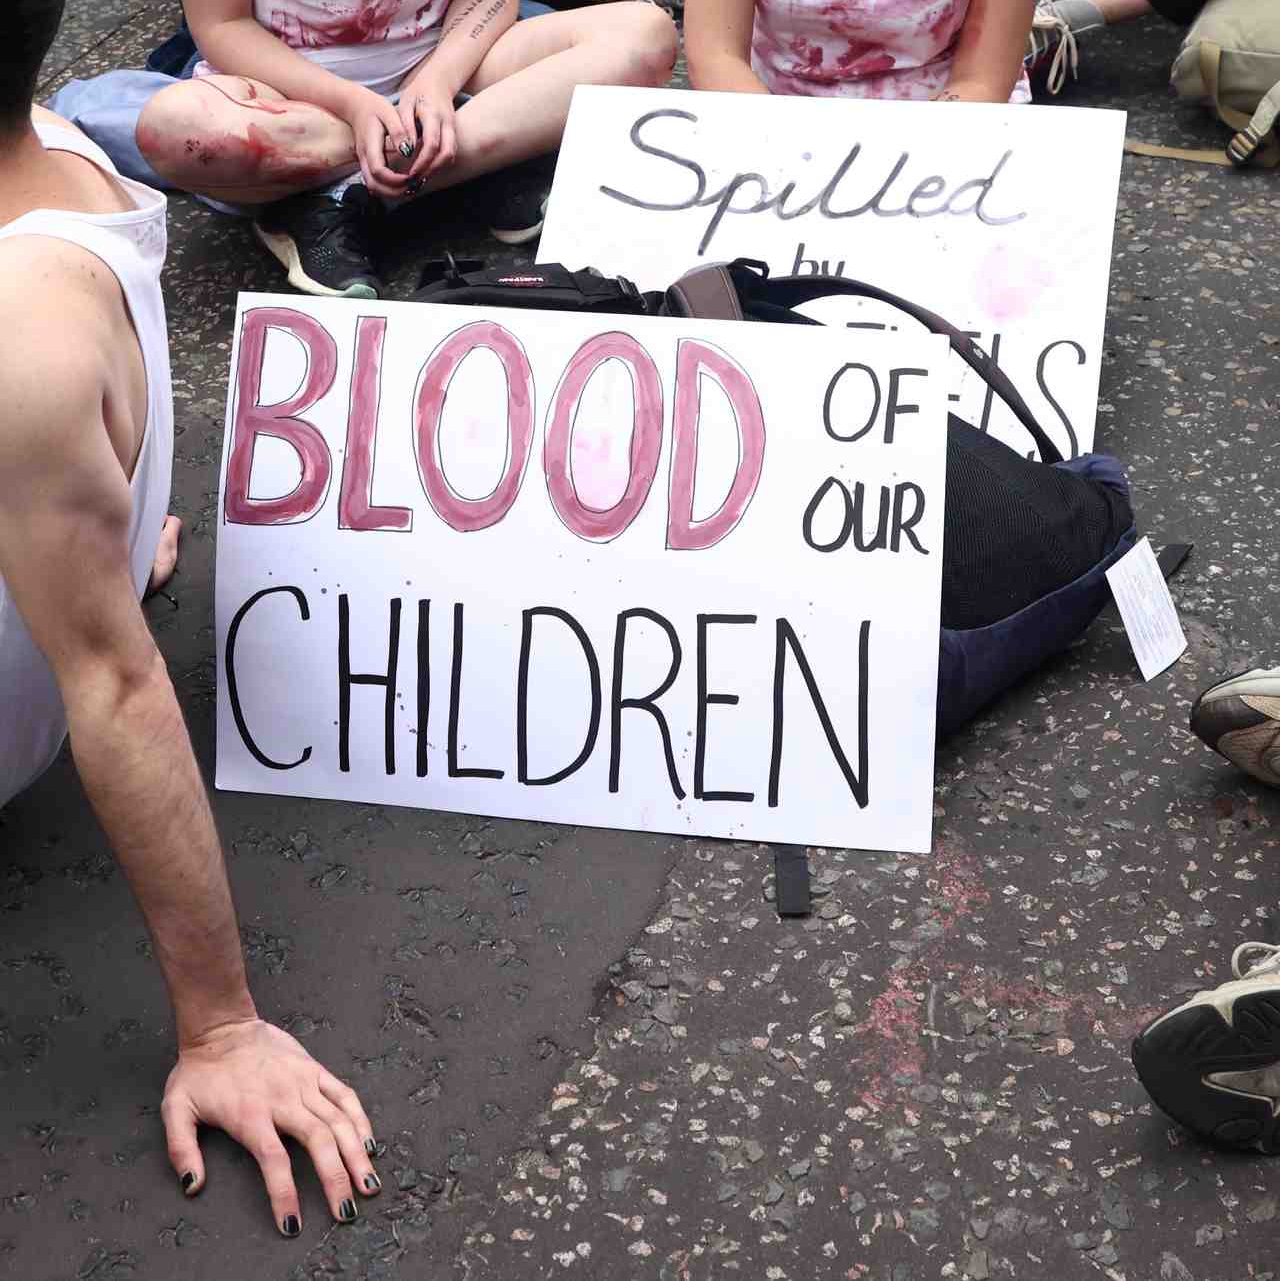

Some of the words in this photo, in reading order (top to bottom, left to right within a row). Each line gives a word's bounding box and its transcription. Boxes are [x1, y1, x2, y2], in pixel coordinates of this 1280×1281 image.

[599, 108, 1027, 256] Spilled
[224, 307, 767, 551] BLOOD
[823, 361, 929, 445] OF
[802, 480, 930, 555] OUR
[225, 585, 871, 810] CHILDREN
